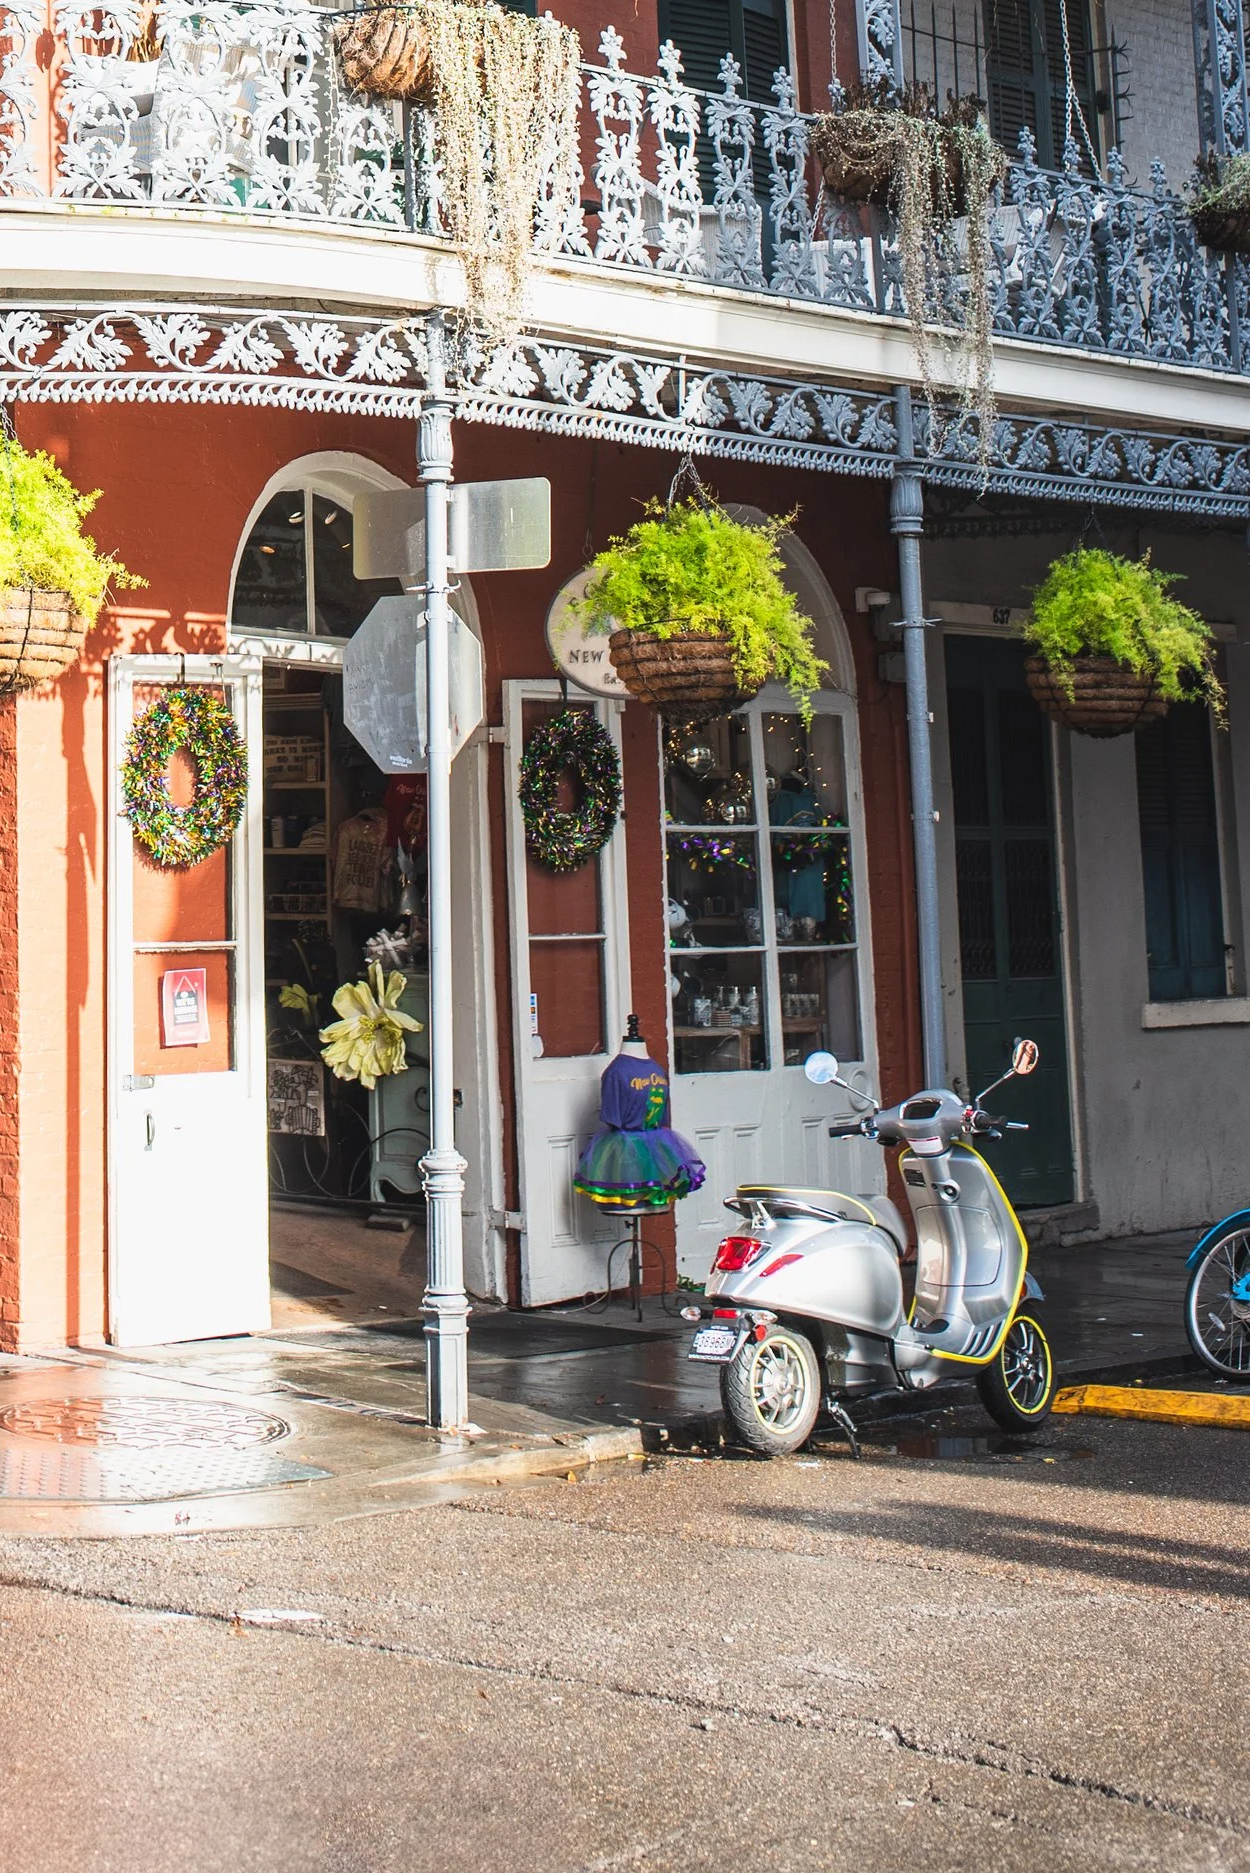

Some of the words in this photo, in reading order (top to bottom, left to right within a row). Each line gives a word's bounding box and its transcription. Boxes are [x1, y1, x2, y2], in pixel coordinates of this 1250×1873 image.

[993, 608, 1010, 624] 637
[569, 649, 605, 664] NEW
[630, 1077, 650, 1090] New
